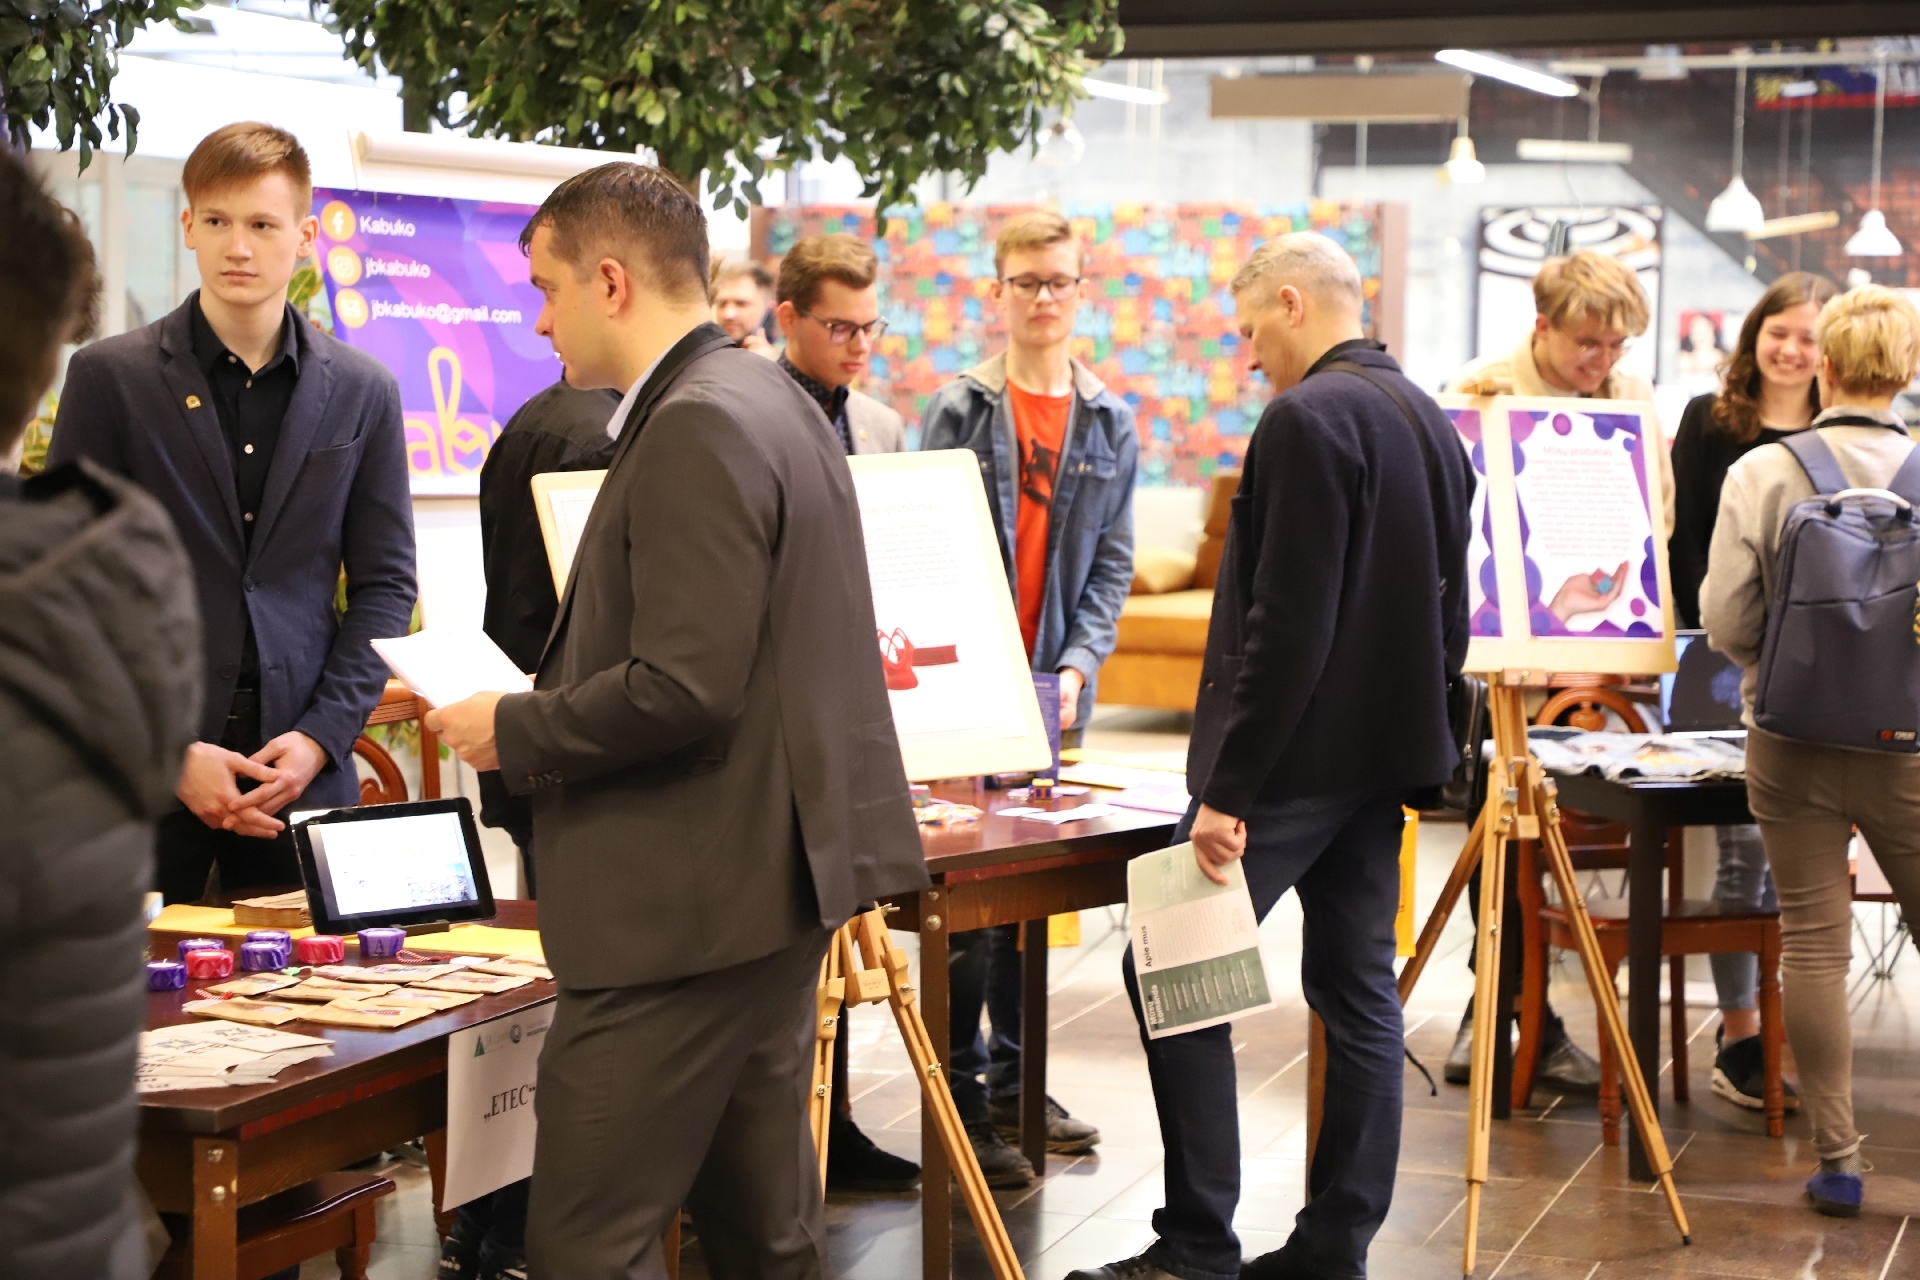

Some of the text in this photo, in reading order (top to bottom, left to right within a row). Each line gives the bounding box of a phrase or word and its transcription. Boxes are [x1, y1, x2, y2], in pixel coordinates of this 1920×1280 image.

[359, 216, 416, 237] Kabuko
[365, 257, 431, 279] jbkabuko
[371, 299, 523, 325] jbkabuko@gmail.com
[1141, 925, 1152, 967] Apie mus
